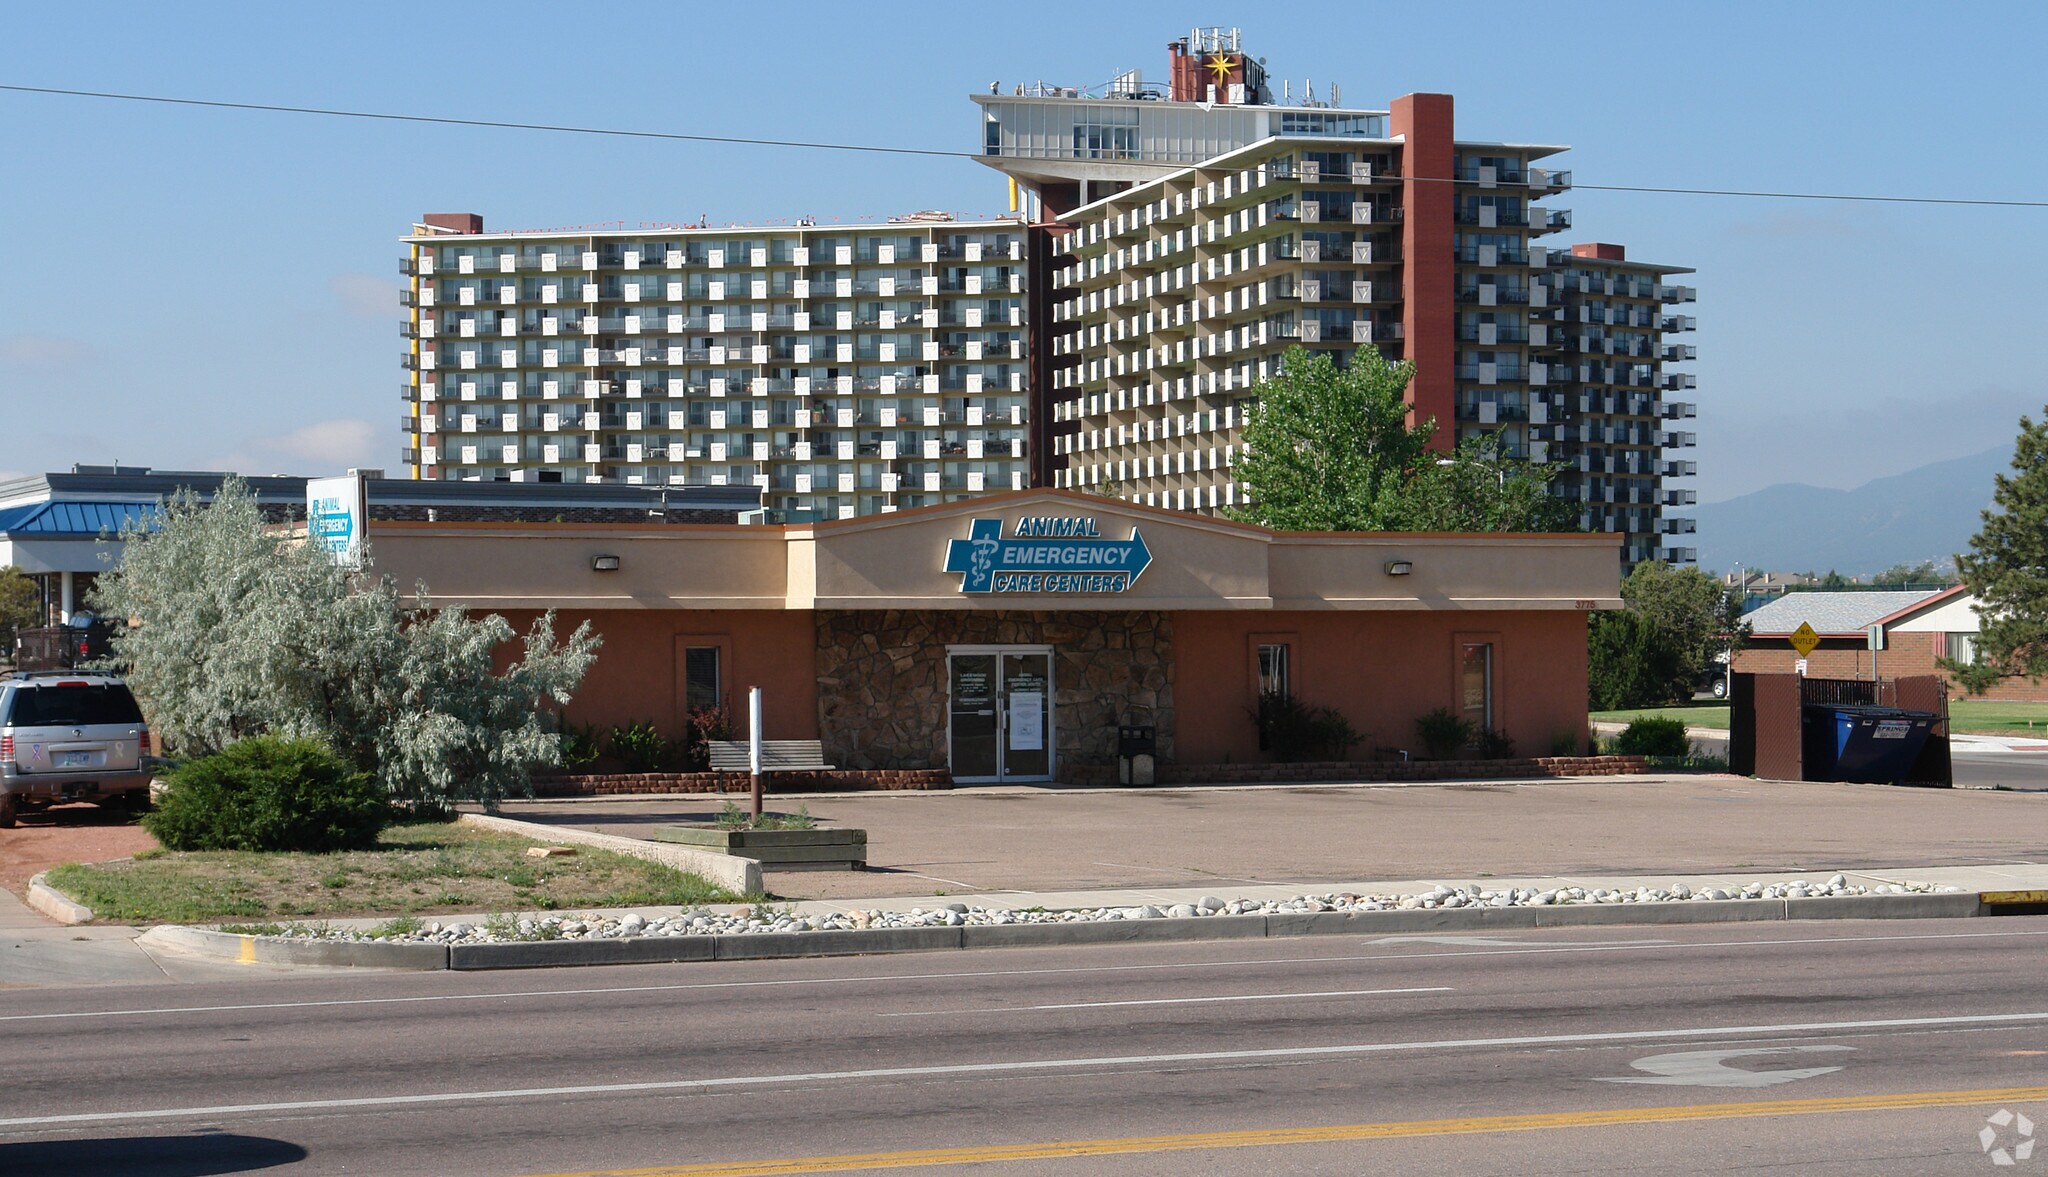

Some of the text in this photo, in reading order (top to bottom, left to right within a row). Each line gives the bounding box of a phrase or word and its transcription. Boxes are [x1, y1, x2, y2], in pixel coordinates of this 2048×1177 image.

[1246, 58, 1264, 89] HOTE
[1015, 516, 1101, 538] ANIMAL
[1003, 546, 1132, 565] EMERGENCY
[995, 574, 1126, 593] CARE CENTERS
